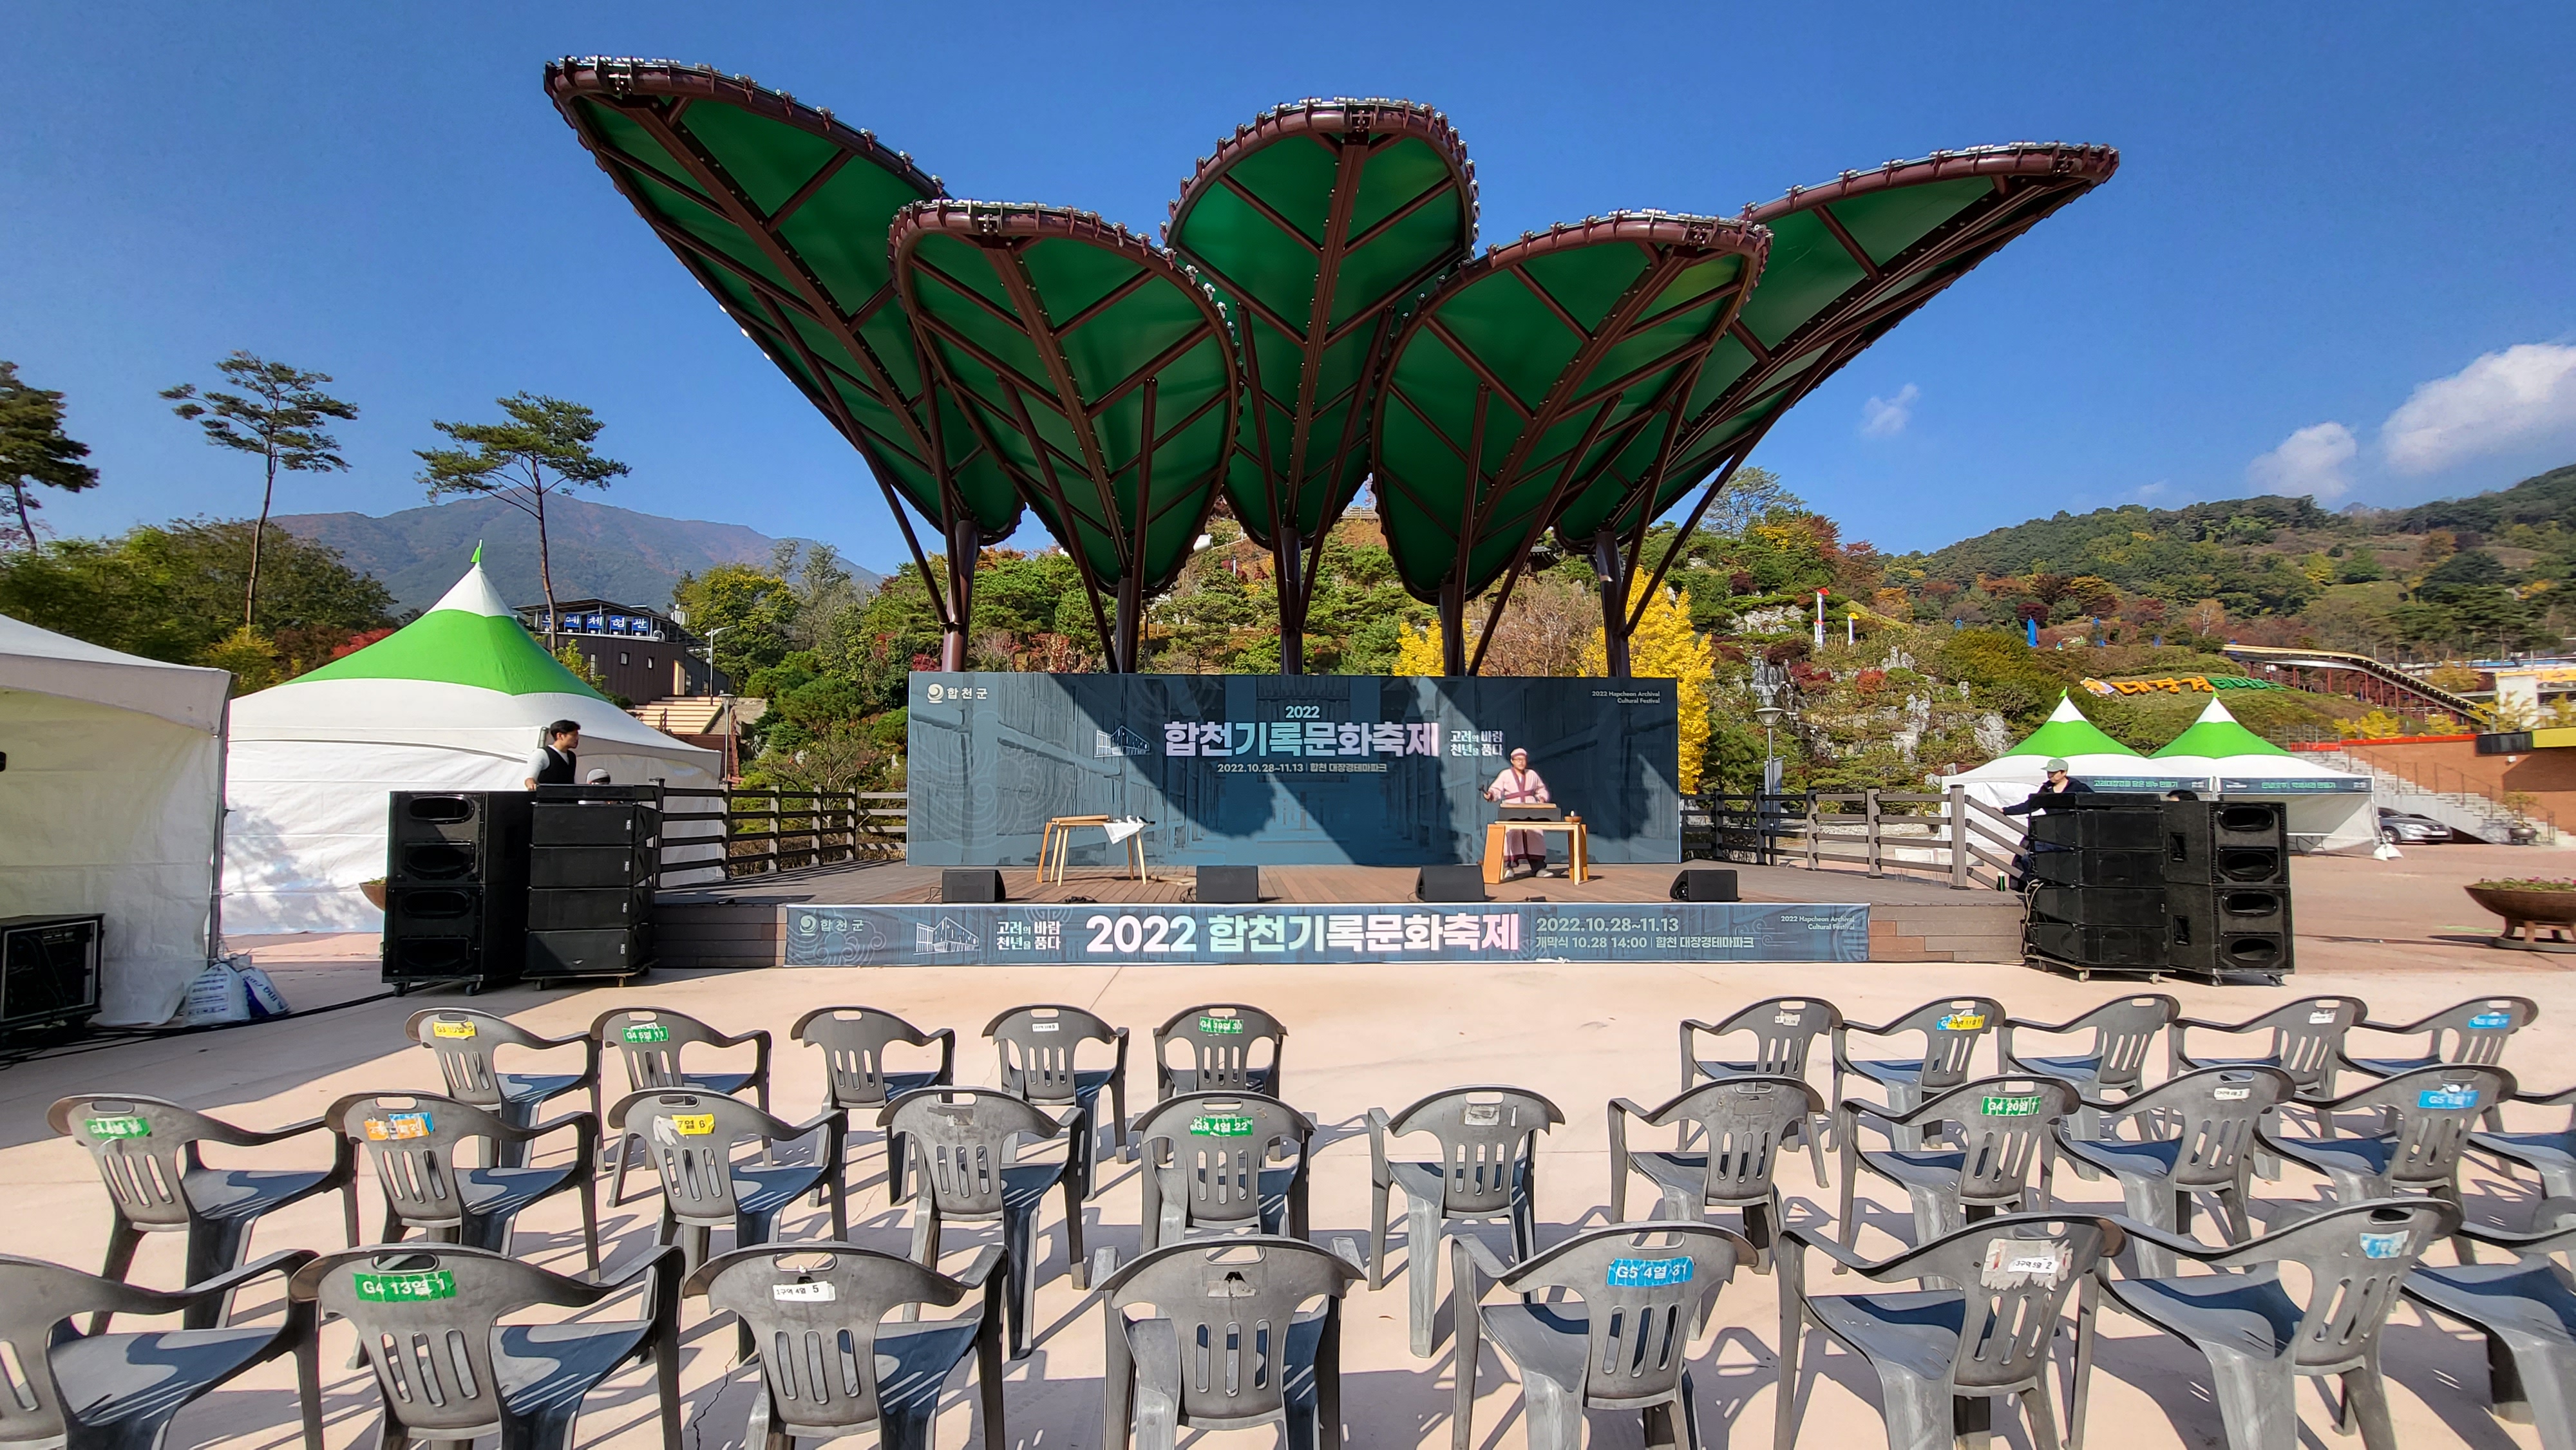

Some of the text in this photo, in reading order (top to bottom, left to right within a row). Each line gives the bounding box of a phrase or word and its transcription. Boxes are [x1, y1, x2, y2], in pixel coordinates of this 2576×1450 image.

[947, 687, 988, 700] 합천군
[1285, 706, 1320, 718] 2022
[1164, 721, 1439, 757] 합천기록문화축제
[1450, 730, 1503, 743] 고려의 바람
[1481, 744, 1503, 757] 품다
[1217, 762, 1387, 773] 2022.10.28~11.13 합천 대장경테마파크
[820, 919, 864, 932] 합천군
[997, 921, 1060, 935] 고려의 바람
[1537, 918, 1679, 932] 2022.10.28~11.13
[1086, 913, 1519, 952] 2022 합천기록문화축제
[1034, 936, 1060, 950] 품다
[1537, 937, 1754, 948] 개막식 10.28 14:00 합천 대장경테마파크
[1988, 1102, 2003, 1111] G4
[678, 1120, 705, 1129] 7열 6
[1235, 1122, 1247, 1131] 22
[1617, 1266, 1638, 1279] G5
[1643, 1266, 1667, 1279] 4열
[363, 1281, 385, 1294] G4
[390, 1279, 430, 1295] 13열
[812, 1285, 819, 1293] 5
